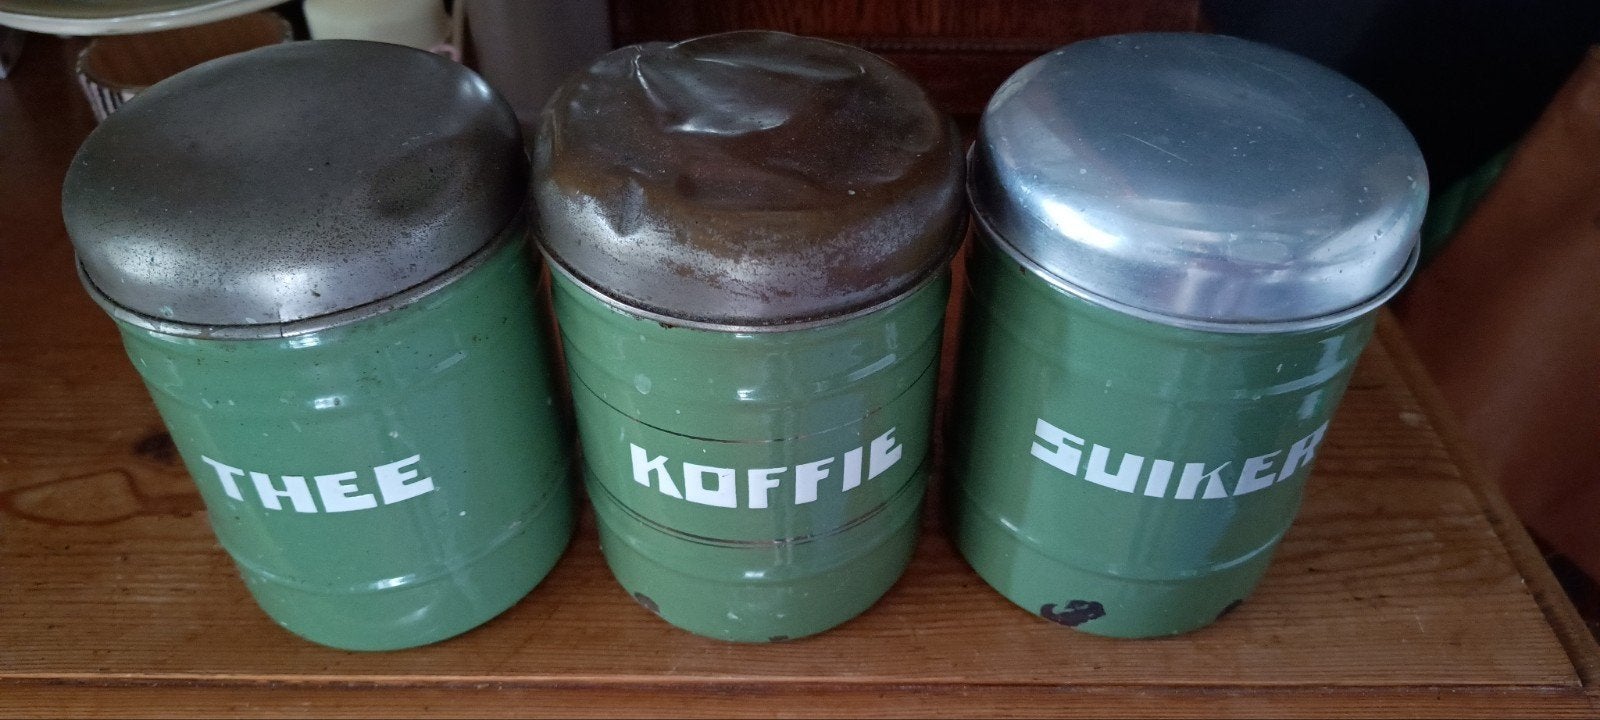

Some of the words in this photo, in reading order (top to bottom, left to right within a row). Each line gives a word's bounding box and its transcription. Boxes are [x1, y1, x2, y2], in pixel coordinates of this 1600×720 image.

[201, 454, 434, 513] THEE
[630, 427, 903, 509] KOFFIE
[1031, 418, 1329, 500] SUIKER
